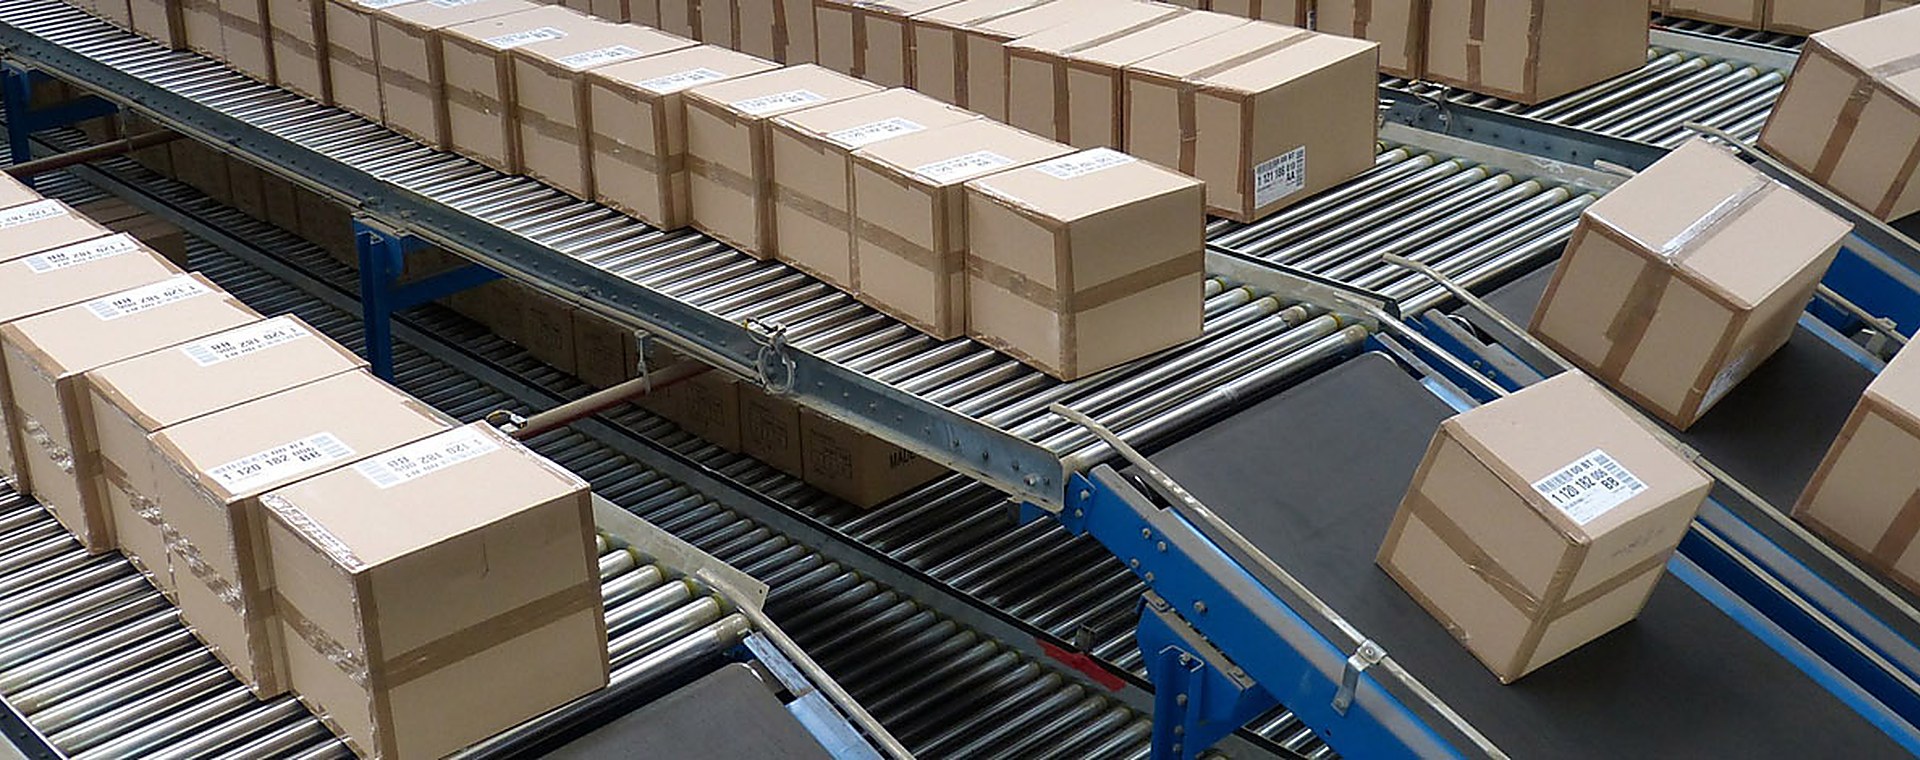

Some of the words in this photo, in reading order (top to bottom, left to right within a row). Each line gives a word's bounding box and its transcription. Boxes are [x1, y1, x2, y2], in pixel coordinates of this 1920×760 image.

[1551, 494, 1563, 503] 1
[1559, 484, 1580, 500] 120
[1575, 475, 1596, 490] 182
[1601, 477, 1619, 490] BB
